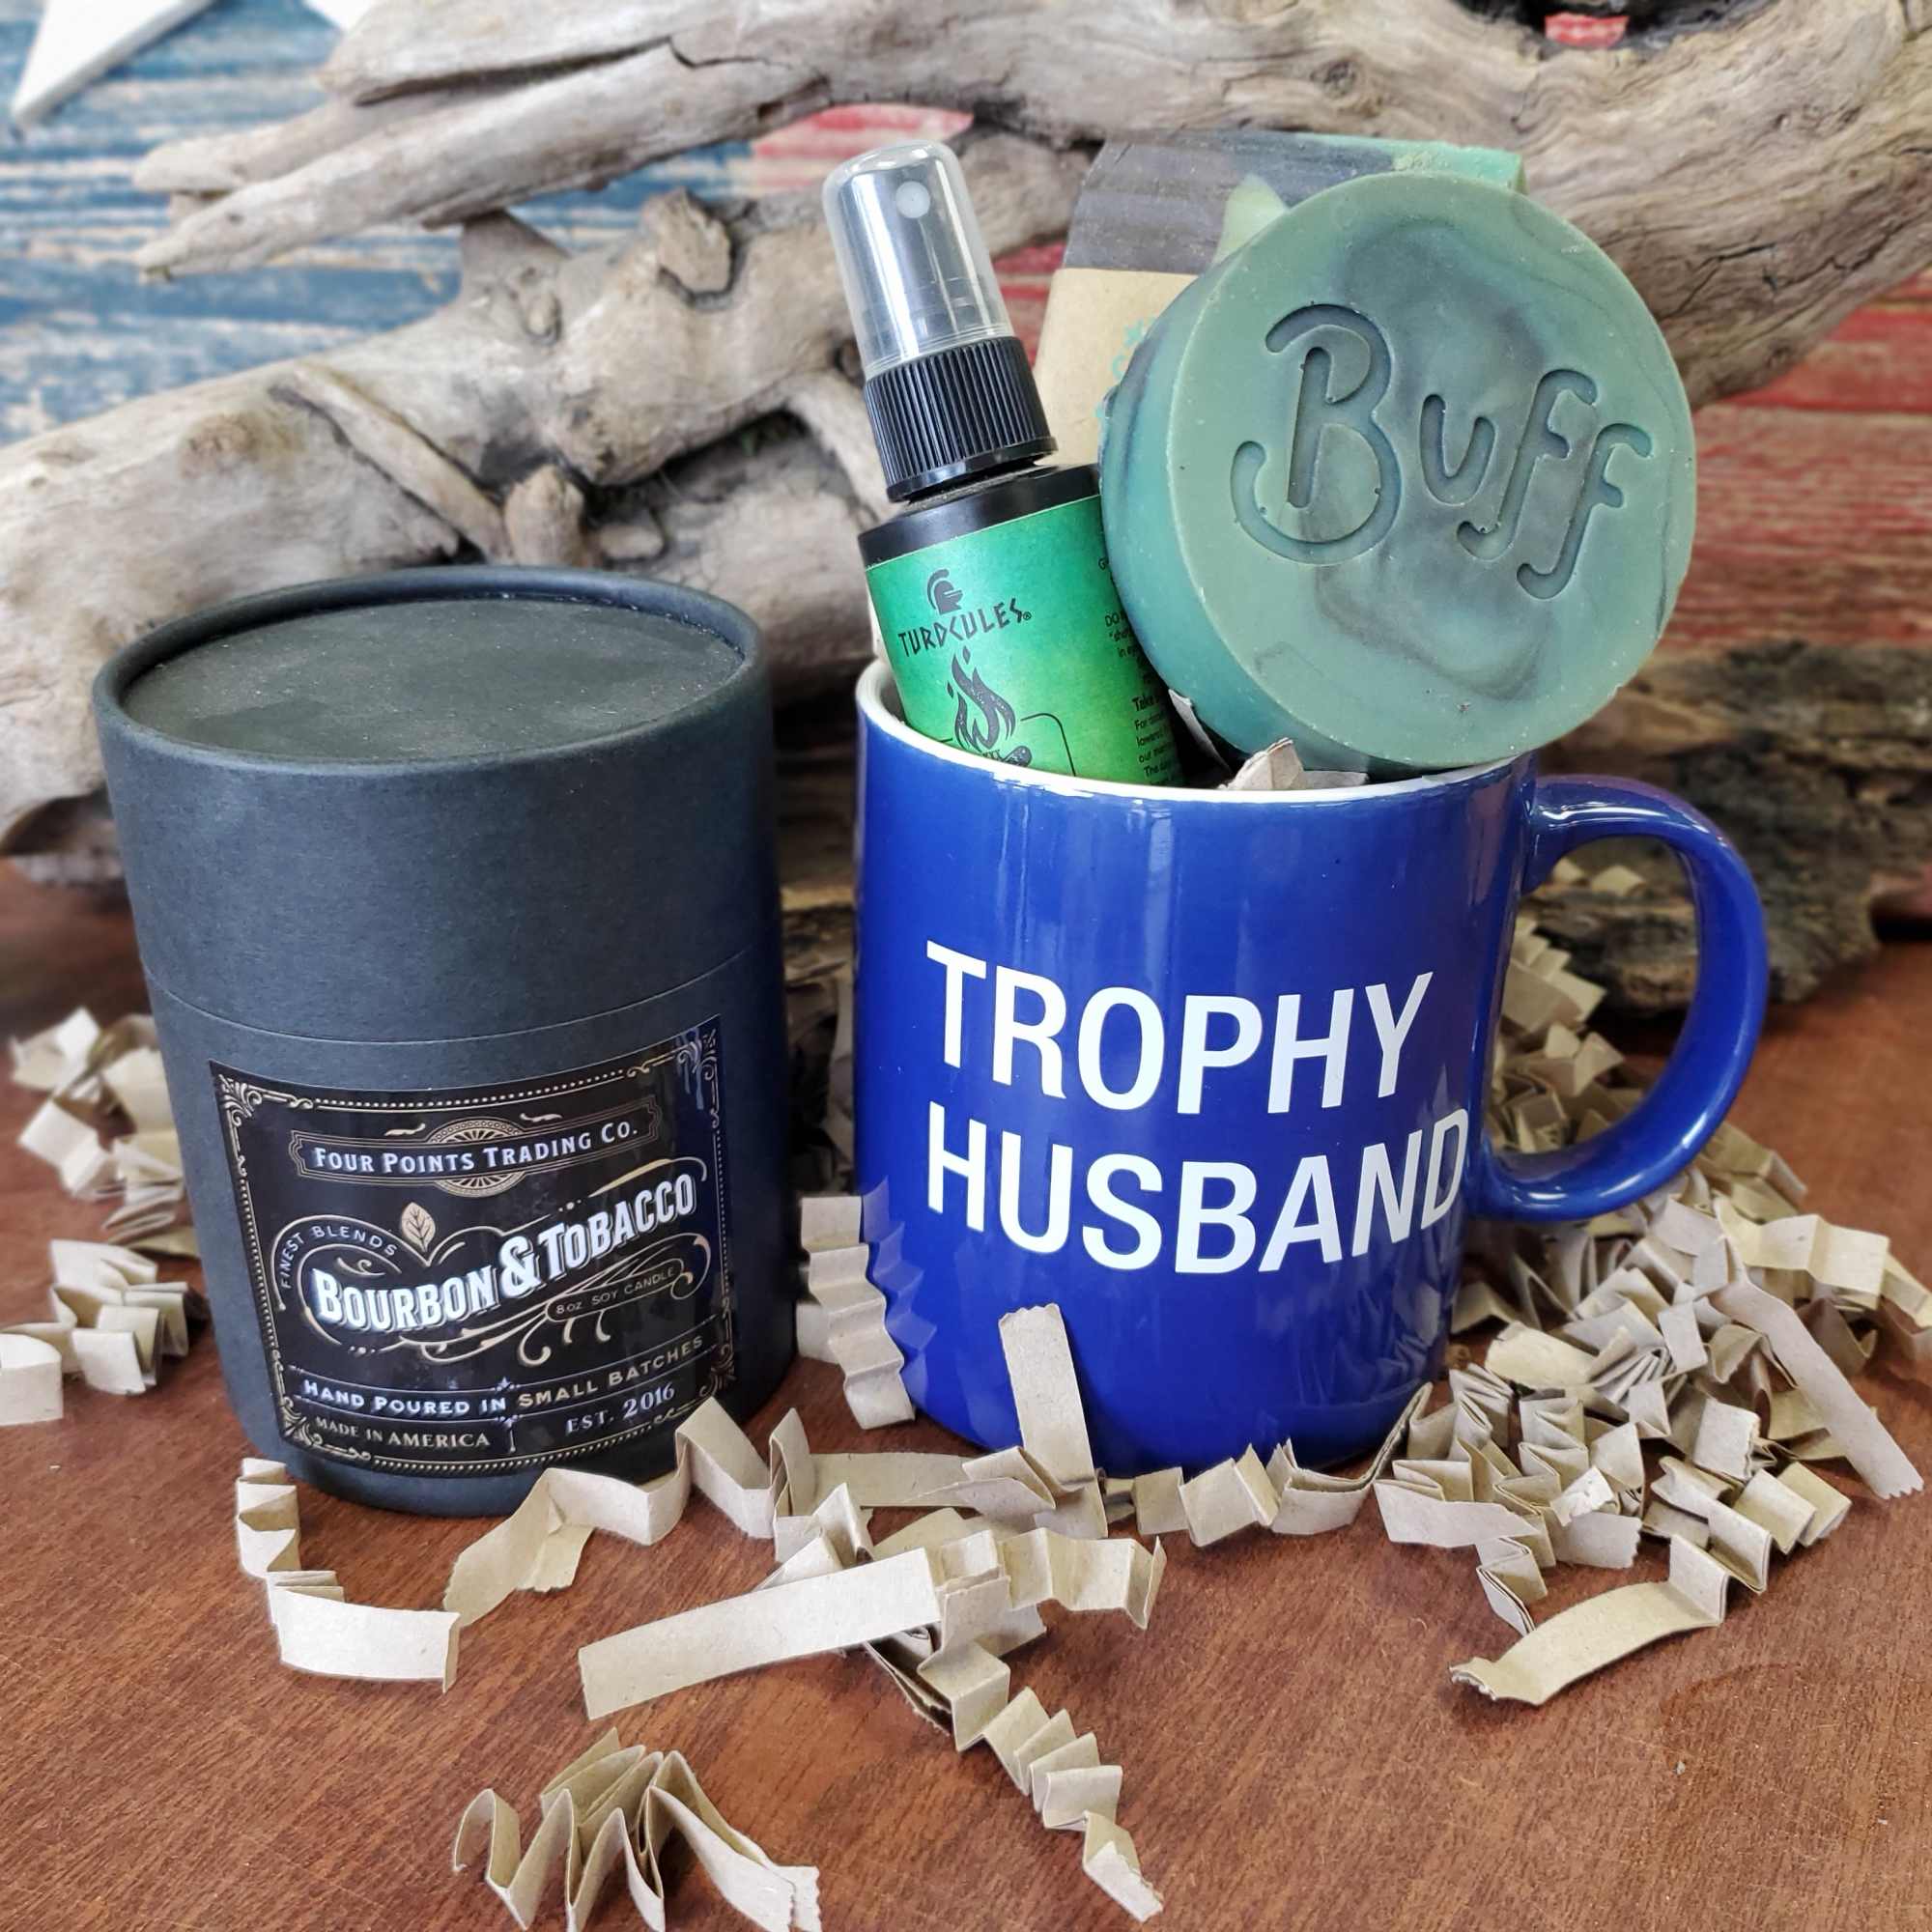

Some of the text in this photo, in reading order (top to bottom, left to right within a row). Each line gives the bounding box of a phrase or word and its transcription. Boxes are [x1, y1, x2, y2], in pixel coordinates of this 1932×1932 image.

[1230, 302, 1652, 600] Buff
[926, 940, 1434, 1115] TROPHY
[314, 1147, 374, 1172] FOUR
[385, 1152, 474, 1174] POINTS
[483, 1132, 592, 1165] TRADING
[927, 1100, 1469, 1274] HUSBAND
[279, 1225, 398, 1289] FINEST BLENDS
[310, 1174, 696, 1333] BOURBON & TOBACCO
[591, 1291, 619, 1305] SOY
[623, 1267, 675, 1294] CANDLE
[302, 1335, 703, 1415] HAND POURED IN SMALL BATCHES
[566, 1381, 675, 1434] EST. 2016
[315, 1416, 491, 1448] MADE IN AMERICA
